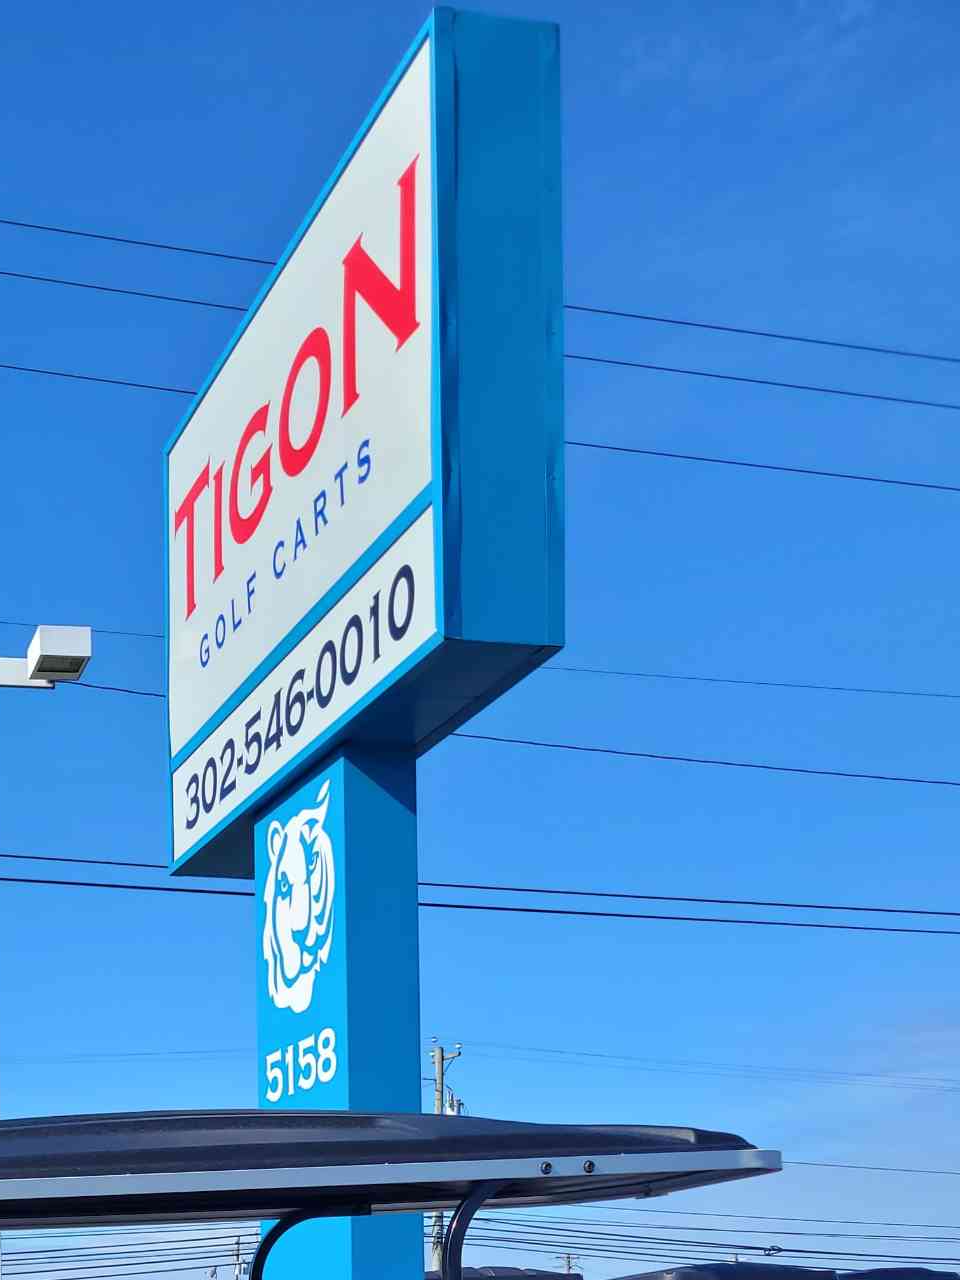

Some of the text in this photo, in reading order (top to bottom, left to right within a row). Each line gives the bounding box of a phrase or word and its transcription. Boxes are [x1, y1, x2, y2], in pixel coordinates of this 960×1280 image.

[174, 154, 421, 621] TIGON
[198, 437, 374, 670] GOLF CARTS
[185, 563, 416, 831] 302-546-0010
[265, 1027, 337, 1103] 5158
